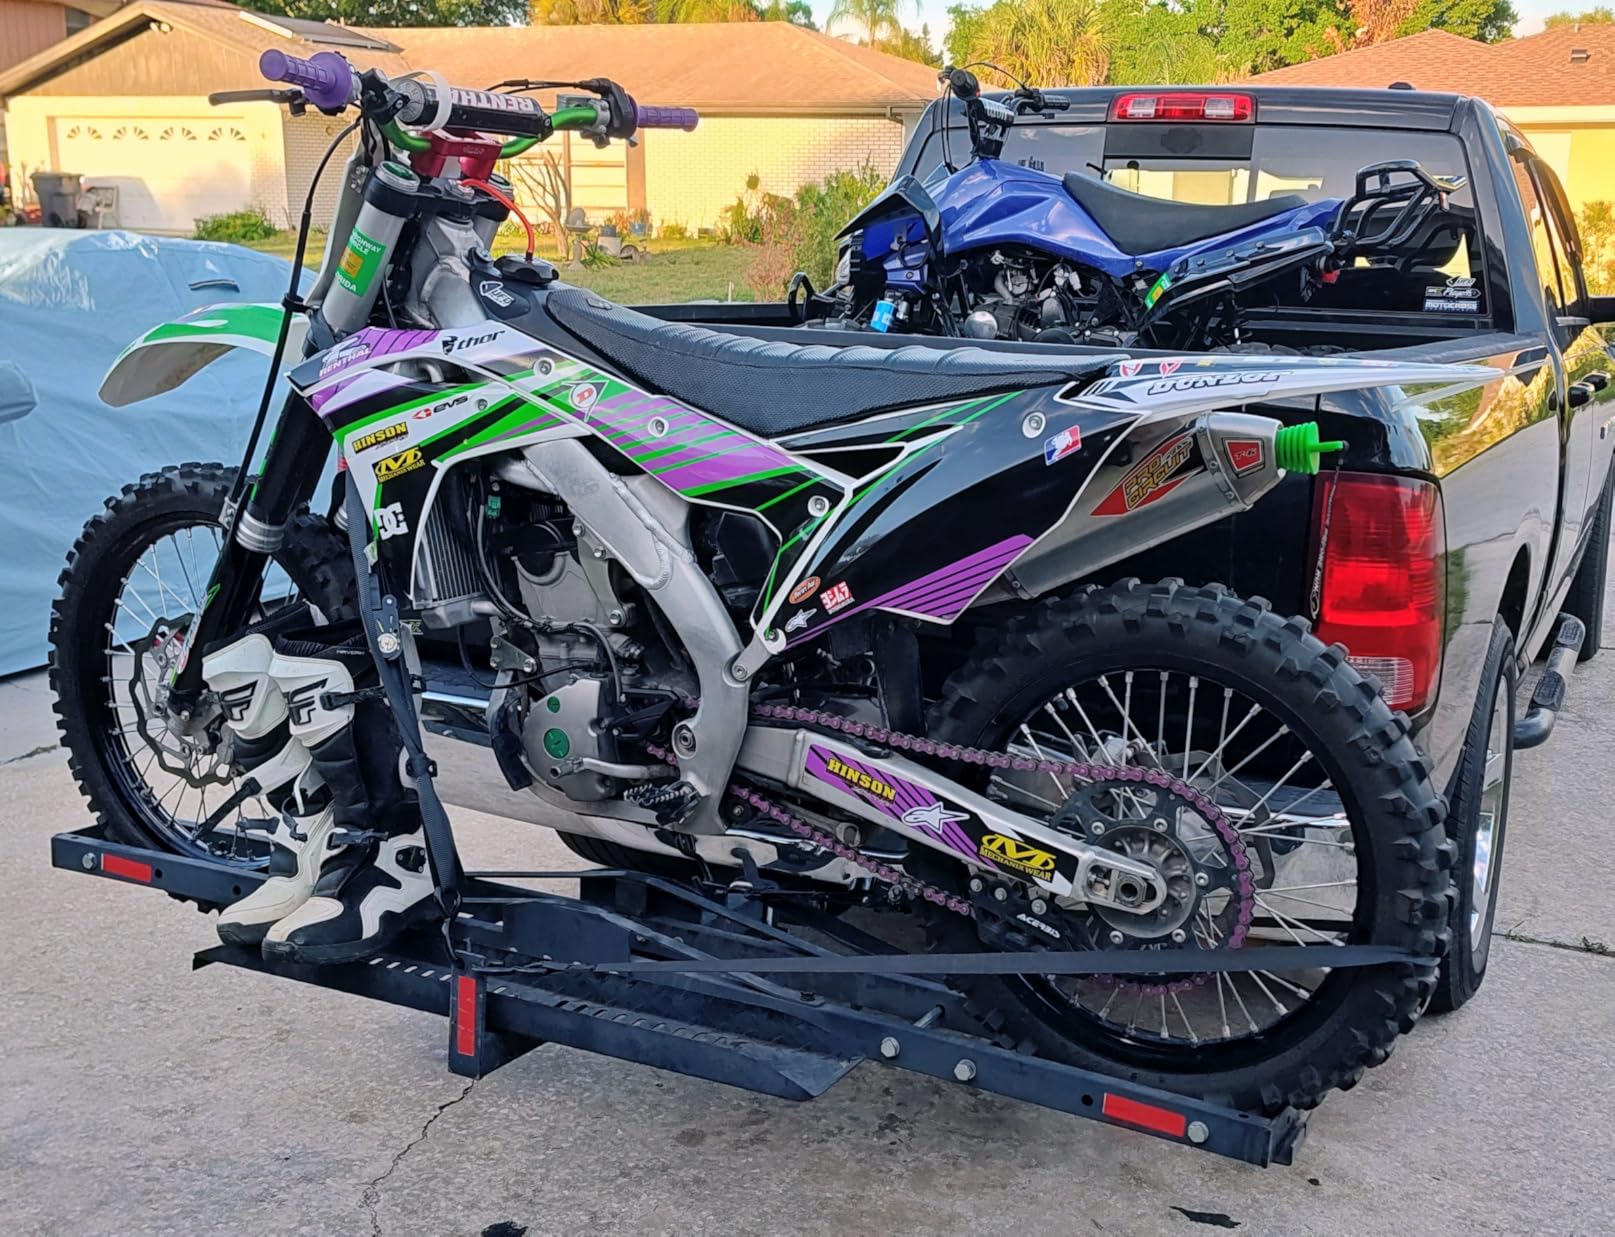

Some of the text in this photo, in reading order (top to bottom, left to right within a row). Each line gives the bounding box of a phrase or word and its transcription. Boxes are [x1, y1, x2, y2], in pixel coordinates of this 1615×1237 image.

[446, 88, 535, 112] RENTHA
[457, 330, 506, 350] thor
[319, 347, 372, 377] RENTHAL
[352, 422, 408, 452] HINSON
[1124, 453, 1162, 496] PRO
[1127, 442, 1193, 510] CIRCUIT
[374, 501, 409, 541] DC
[827, 758, 897, 802] HINSON
[980, 846, 1052, 881] MECHANIX WEAR
[1016, 913, 1060, 939] ACERBIS
